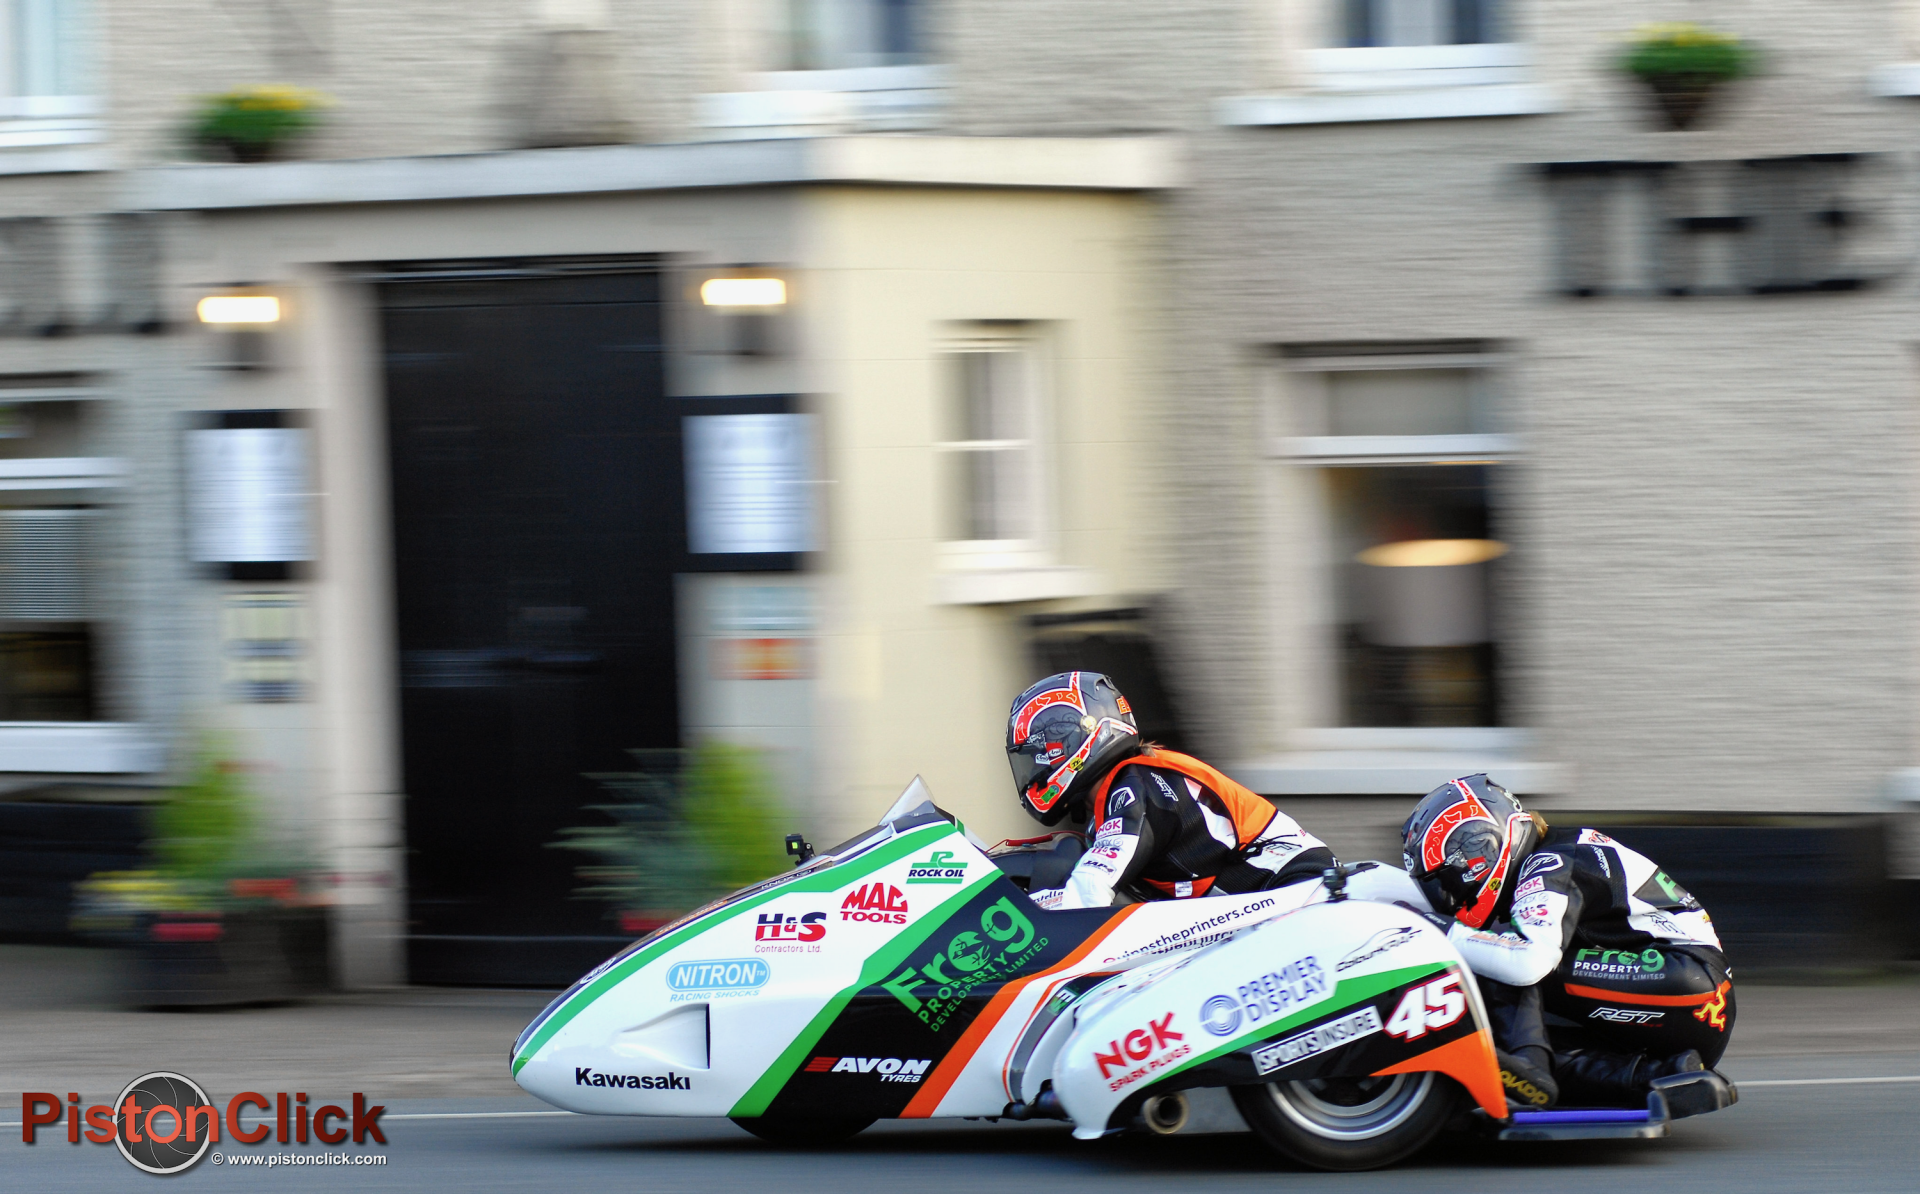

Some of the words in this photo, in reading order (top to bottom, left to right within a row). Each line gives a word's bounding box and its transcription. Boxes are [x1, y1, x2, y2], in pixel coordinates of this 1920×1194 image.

[1097, 819, 1121, 835] NGK
[908, 869, 943, 877] ROCK
[944, 869, 964, 877] OIL
[841, 882, 908, 912] MAC
[1516, 877, 1542, 896] NGK
[755, 912, 827, 942] H&S
[840, 911, 907, 924] TOOLS
[754, 945, 804, 953] Contractors
[881, 896, 1035, 1014] Frog
[674, 963, 757, 987] NITRON
[1572, 970, 1630, 981] DEVELOPMENT
[1632, 972, 1666, 981] LIMITED
[1574, 961, 1641, 974] PROPERTY
[918, 952, 1009, 1024] PROPERTY
[930, 972, 1003, 1033] DEVELOPMENT
[1004, 936, 1050, 973] LIMITED
[1236, 955, 1323, 1004] PREMIER
[669, 991, 711, 1002] RACING
[714, 989, 761, 999] SHOCKS
[1244, 972, 1328, 1022] DISPLAY
[1383, 970, 1468, 1042] 45
[1588, 1006, 1666, 1024] RST
[1093, 1011, 1184, 1080] NGK
[831, 1057, 932, 1075] AVON
[1109, 1064, 1150, 1093] SPARK
[1148, 1043, 1192, 1072] PLUGS
[575, 1067, 691, 1090] Kawasaki
[880, 1074, 922, 1083] TYRES
